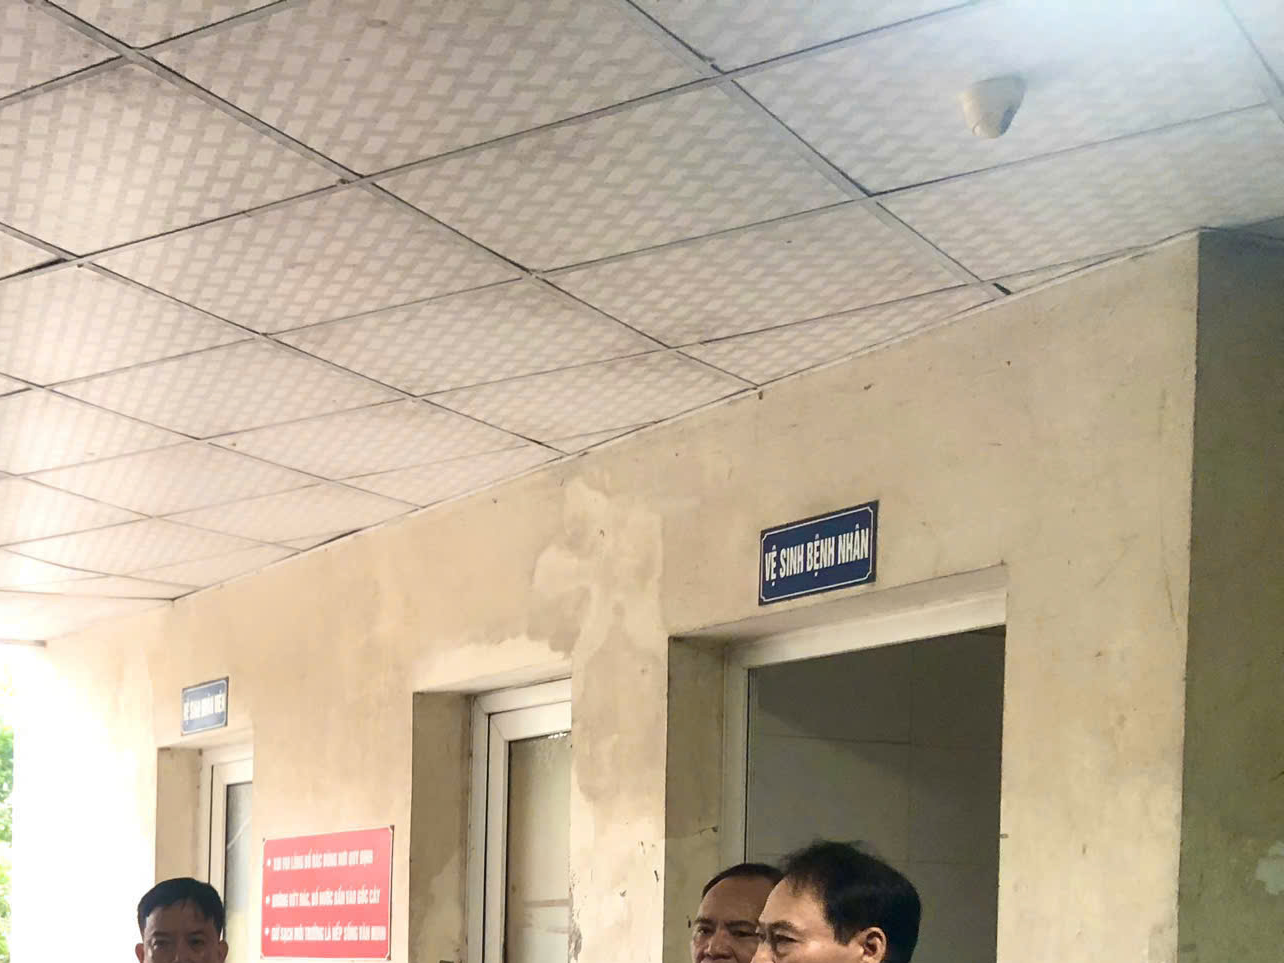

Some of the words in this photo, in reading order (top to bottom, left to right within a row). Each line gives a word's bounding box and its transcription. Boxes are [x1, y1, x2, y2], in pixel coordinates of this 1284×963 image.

[765, 545, 777, 587] VỆ
[779, 543, 805, 579] SINH
[806, 533, 836, 577] BỆNH
[837, 523, 870, 566] NHÂN
